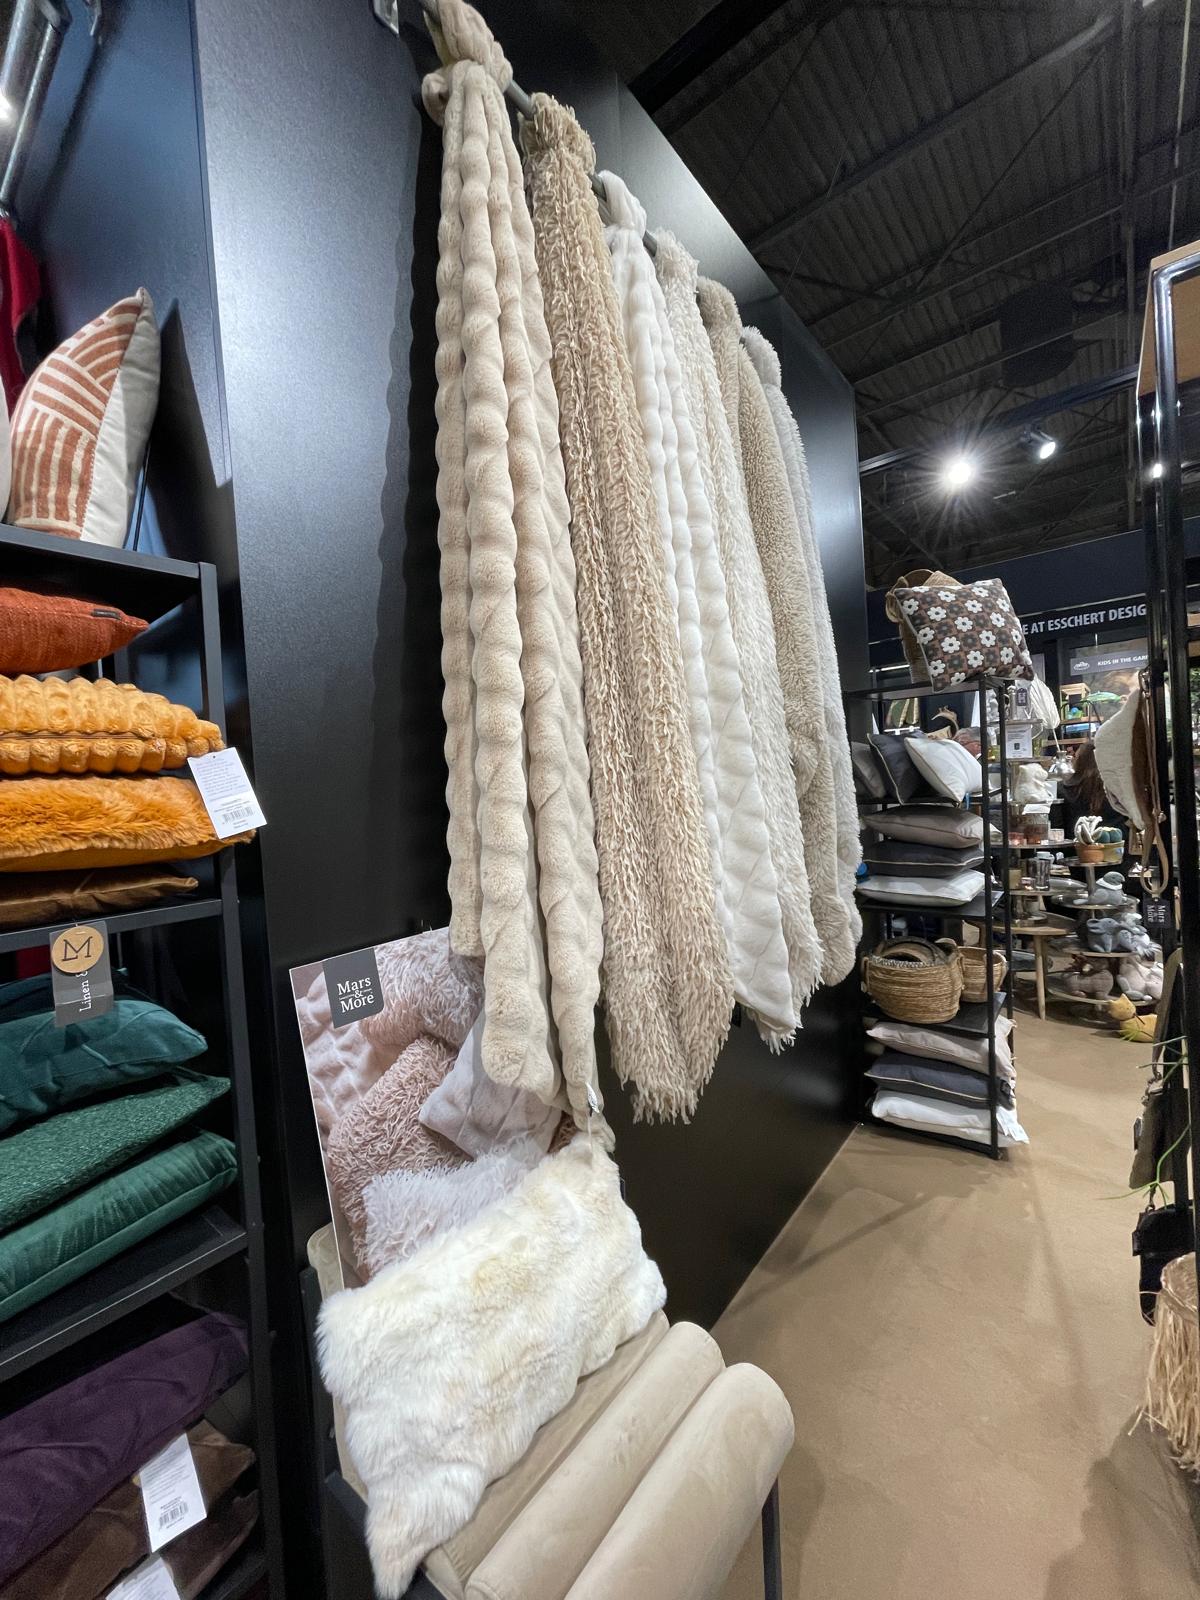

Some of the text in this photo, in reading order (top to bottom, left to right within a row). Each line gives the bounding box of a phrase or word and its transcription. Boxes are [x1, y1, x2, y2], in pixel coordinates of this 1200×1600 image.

[1031, 621, 1045, 634] AT
[1047, 611, 1106, 631] ESSCHERT
[1108, 604, 1147, 621] DESIG
[1147, 905, 1155, 923] More
[1157, 905, 1166, 923] Mars
[79, 979, 92, 1012] Linen
[336, 977, 372, 996] Mars
[354, 989, 364, 999] &
[340, 994, 375, 1014] More
